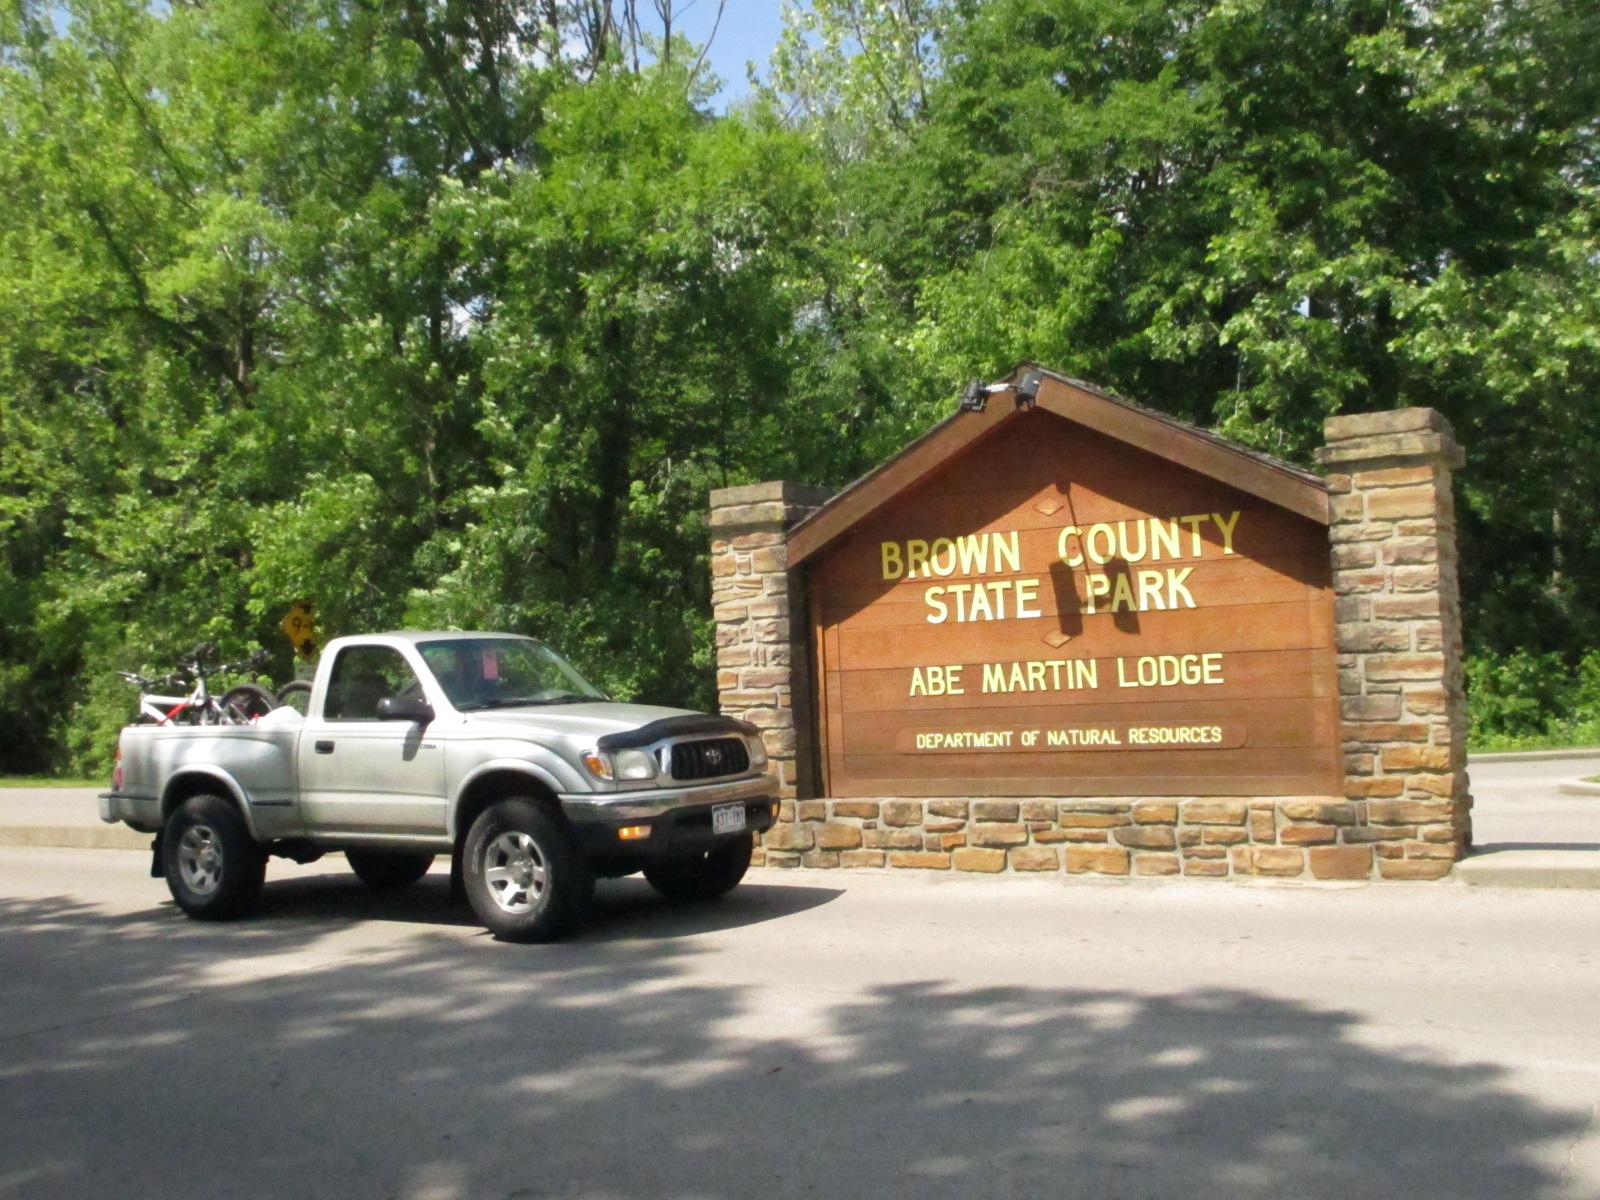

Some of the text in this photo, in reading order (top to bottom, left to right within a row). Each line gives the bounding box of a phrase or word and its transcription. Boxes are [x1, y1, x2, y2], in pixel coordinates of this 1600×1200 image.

[882, 511, 1241, 580] BROWN COUNTY
[925, 567, 1197, 624] STATE PARK
[909, 653, 1224, 696] ABE MARTIN LODGE
[916, 727, 1222, 749] DEPARTMENT OF NATURAL RESOURCES
